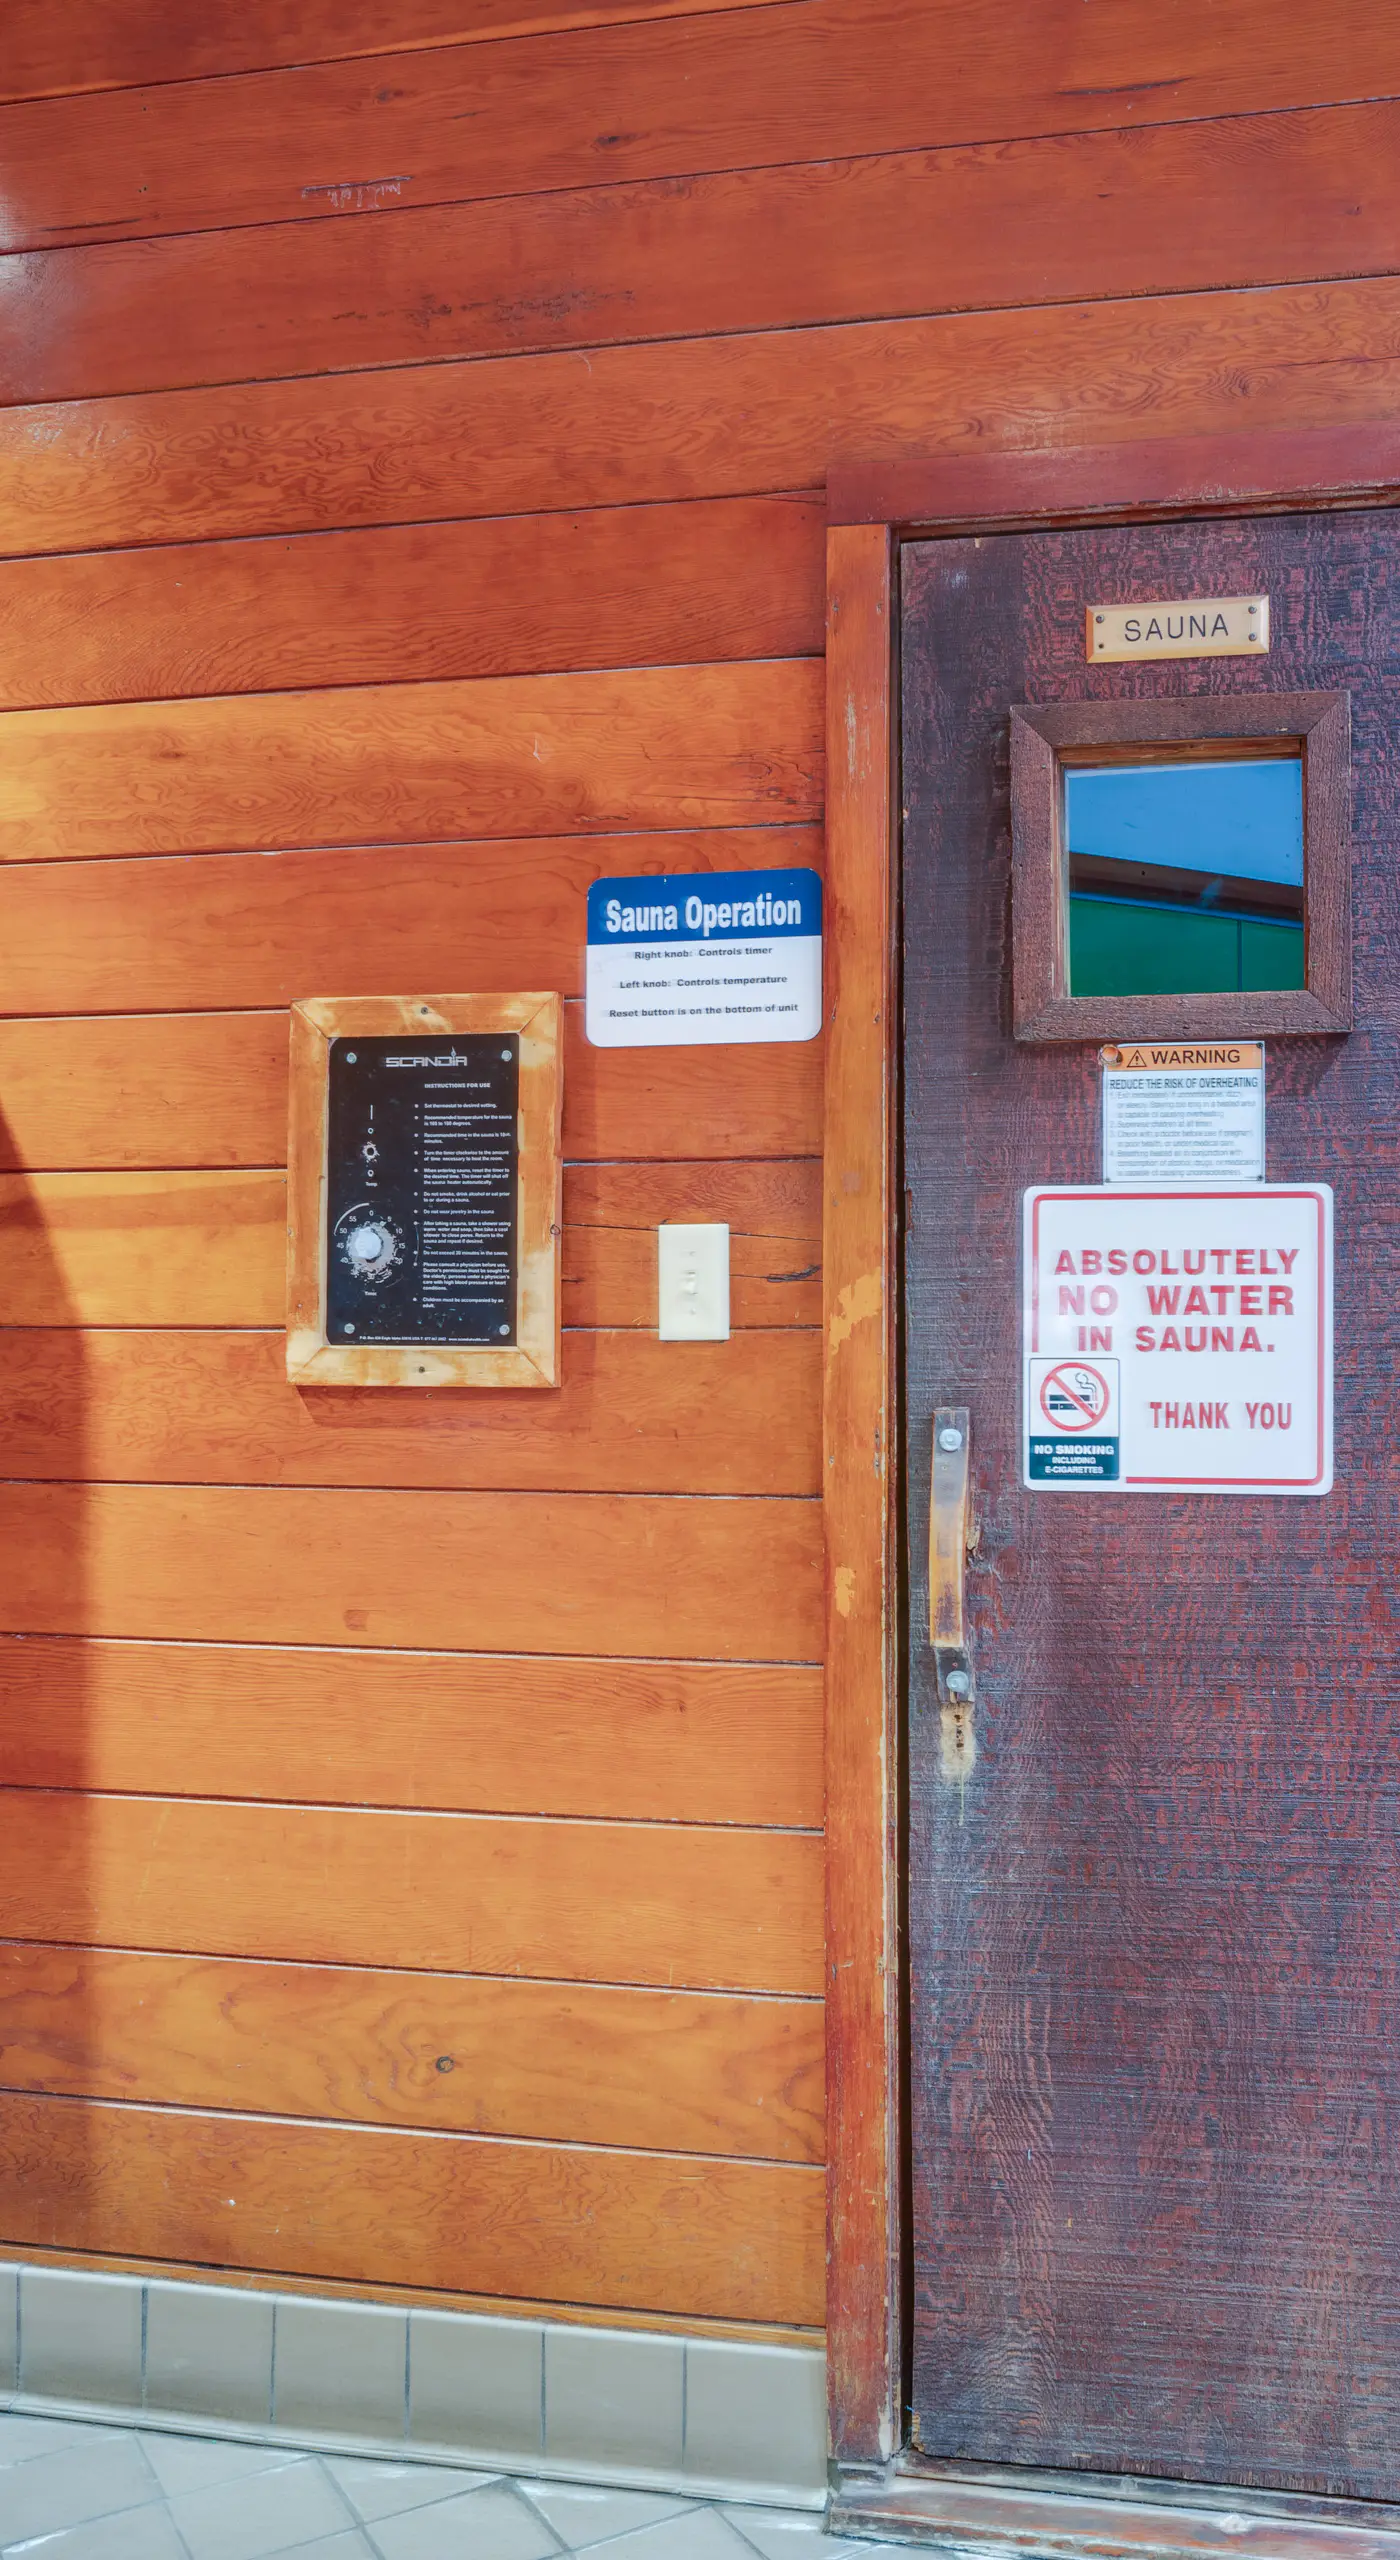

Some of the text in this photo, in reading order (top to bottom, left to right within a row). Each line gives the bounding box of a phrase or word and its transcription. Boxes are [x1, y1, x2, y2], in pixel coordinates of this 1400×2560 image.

[1125, 614, 1228, 641] SAUNA
[606, 893, 801, 937] Sauna Operation
[635, 946, 773, 961] Right knob: Controls timer
[620, 975, 788, 989] Left knob: Controls temperature
[609, 1009, 638, 1018] Reset
[641, 1008, 674, 1017] button
[678, 1008, 686, 1016] is
[705, 1006, 722, 1015] the
[725, 1005, 762, 1014] bottom
[765, 1004, 776, 1013] of
[778, 1004, 799, 1012] unit
[385, 1052, 468, 1067] SCANDIA
[1151, 1049, 1240, 1064] WARNING
[1109, 1077, 1258, 1090] REDUCE THE RISK OF OVERHEATING
[1054, 1249, 1300, 1276] ABSOLUTELY
[1058, 1285, 1294, 1316] NO WATER
[1077, 1326, 1275, 1352] IN SAUNA.
[1150, 1402, 1292, 1429] THANK YOU
[1034, 1445, 1114, 1455] NO SMOKING
[1052, 1456, 1096, 1464] INCLUDING
[1044, 1465, 1104, 1474] E-CIGARETTES
